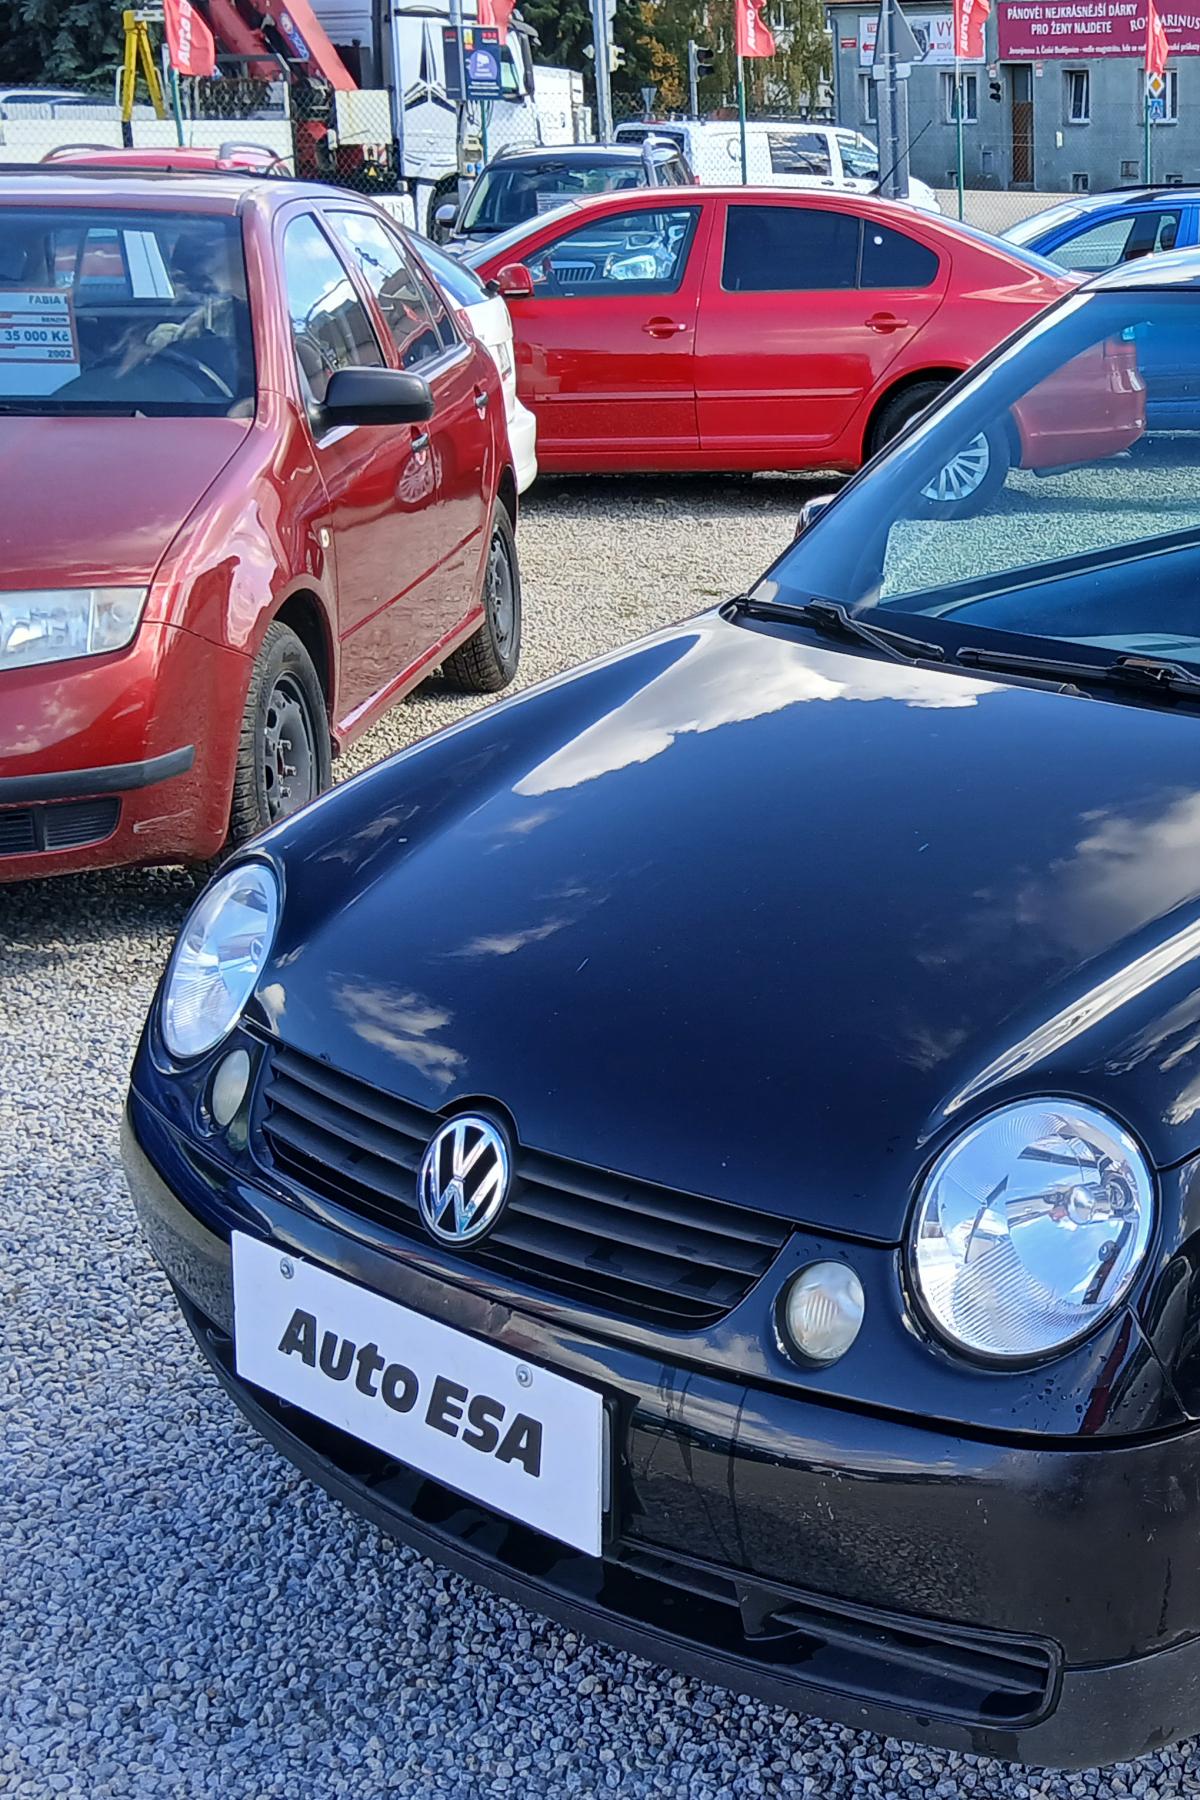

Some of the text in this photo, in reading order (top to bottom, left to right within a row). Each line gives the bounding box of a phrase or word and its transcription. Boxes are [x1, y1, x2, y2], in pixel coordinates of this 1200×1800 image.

[1045, 3, 1107, 19] NEJKRÁSNĚJŠÍ
[1108, 2, 1138, 17] DÁRKY
[1031, 21, 1113, 35] PRO ŽENY NAJDETE
[1129, 14, 1200, 32] ROARINUS
[28, 295, 61, 305] FABIA
[4, 330, 69, 341] 35 000 Kč
[47, 349, 71, 358] 2002
[278, 1307, 543, 1479] Auto ESA
